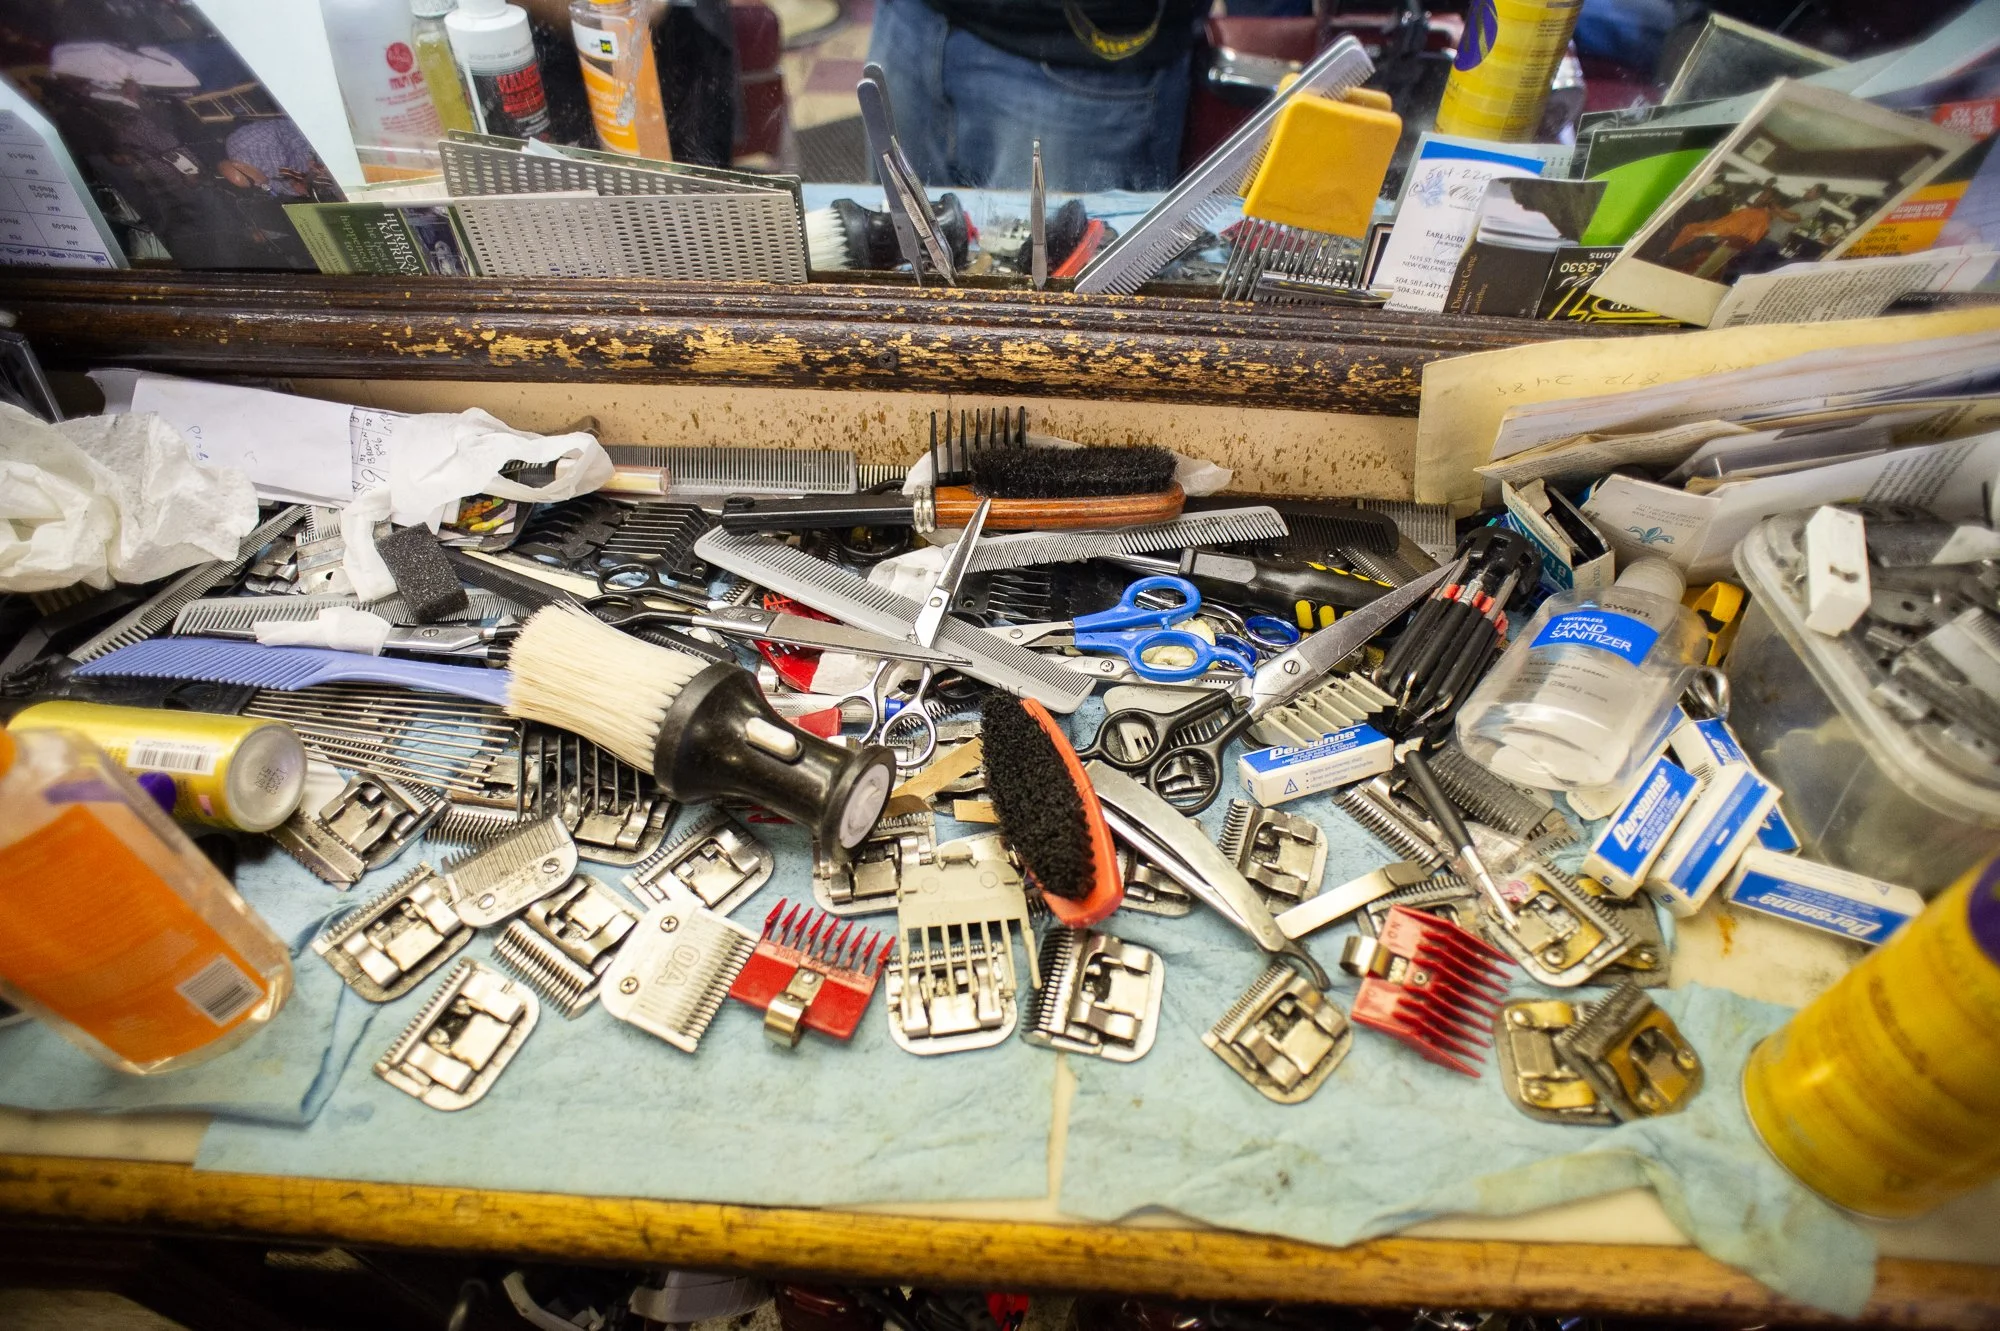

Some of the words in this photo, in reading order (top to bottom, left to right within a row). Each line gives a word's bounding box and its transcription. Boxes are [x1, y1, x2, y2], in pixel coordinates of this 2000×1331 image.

[1549, 631, 1632, 651] SANITIZER
[1557, 623, 1607, 633] HAND
[1610, 773, 1671, 851] Personna
[1757, 892, 1882, 935] Personna
